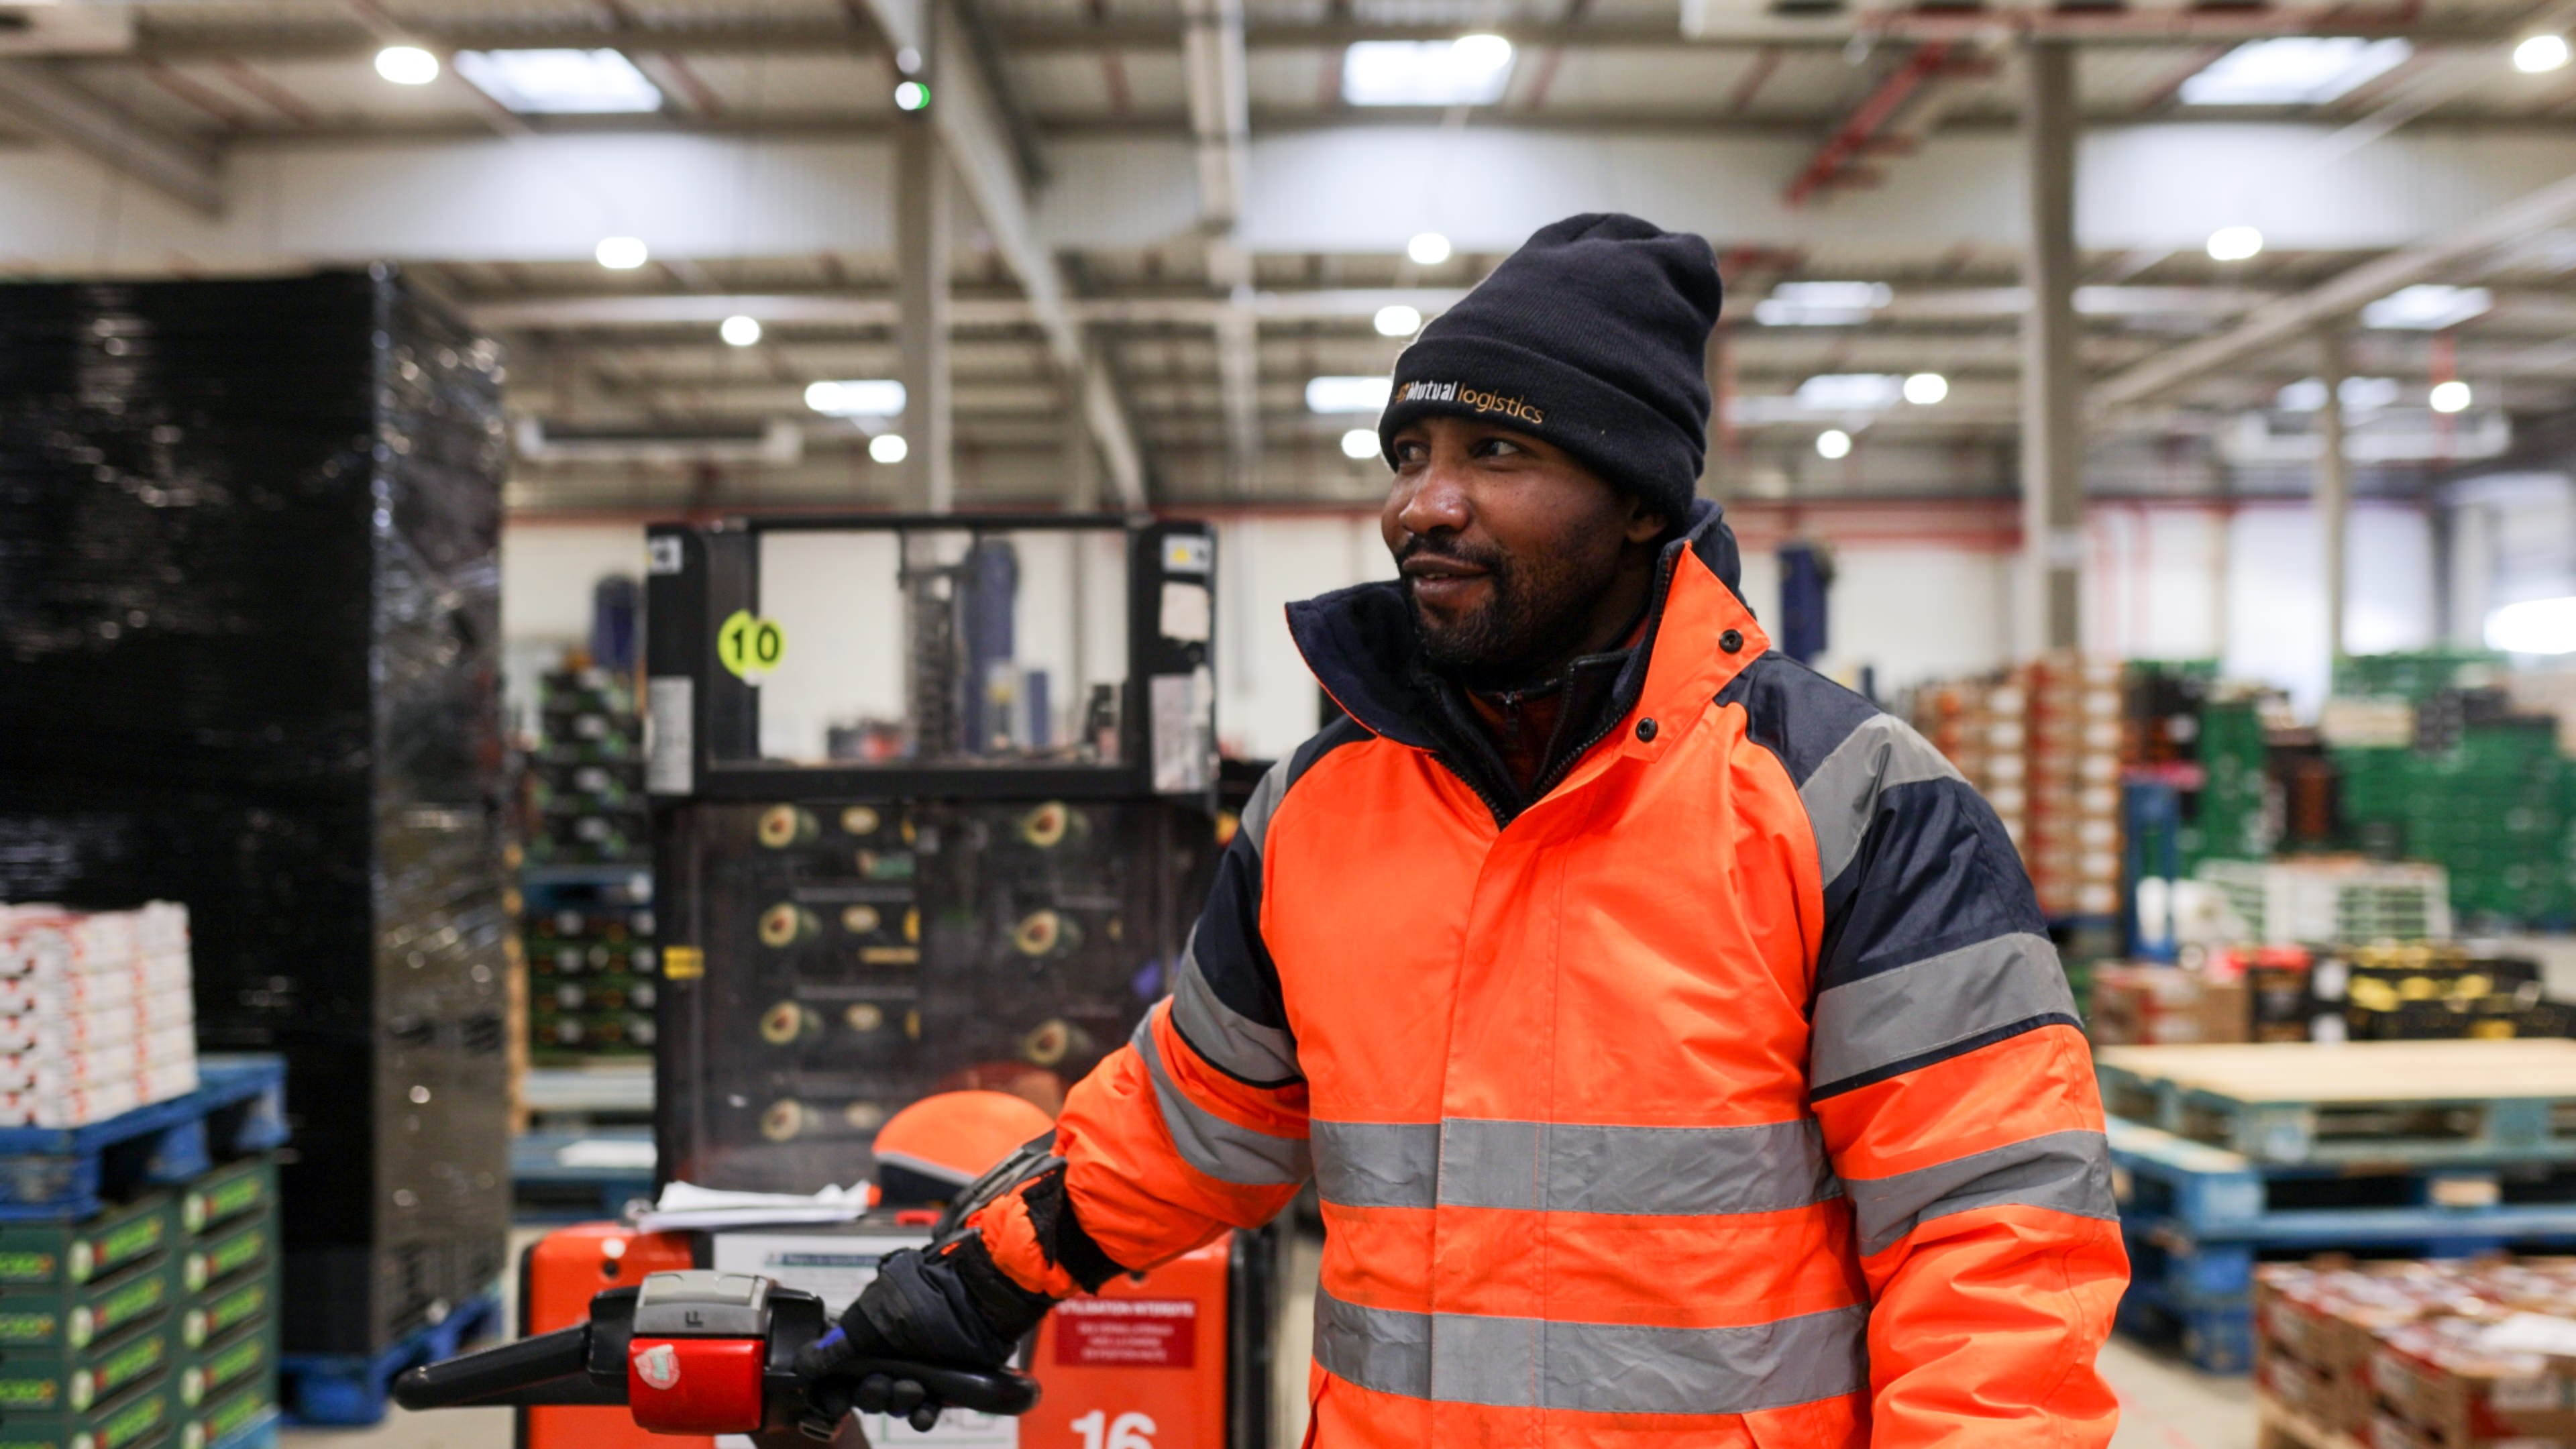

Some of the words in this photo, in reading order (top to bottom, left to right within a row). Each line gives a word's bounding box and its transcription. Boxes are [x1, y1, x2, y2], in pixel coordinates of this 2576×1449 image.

[1406, 380, 1458, 401] Mutual
[1458, 382, 1544, 424] logistics
[731, 625, 779, 662] 10
[1071, 1409, 1157, 1449] 16
